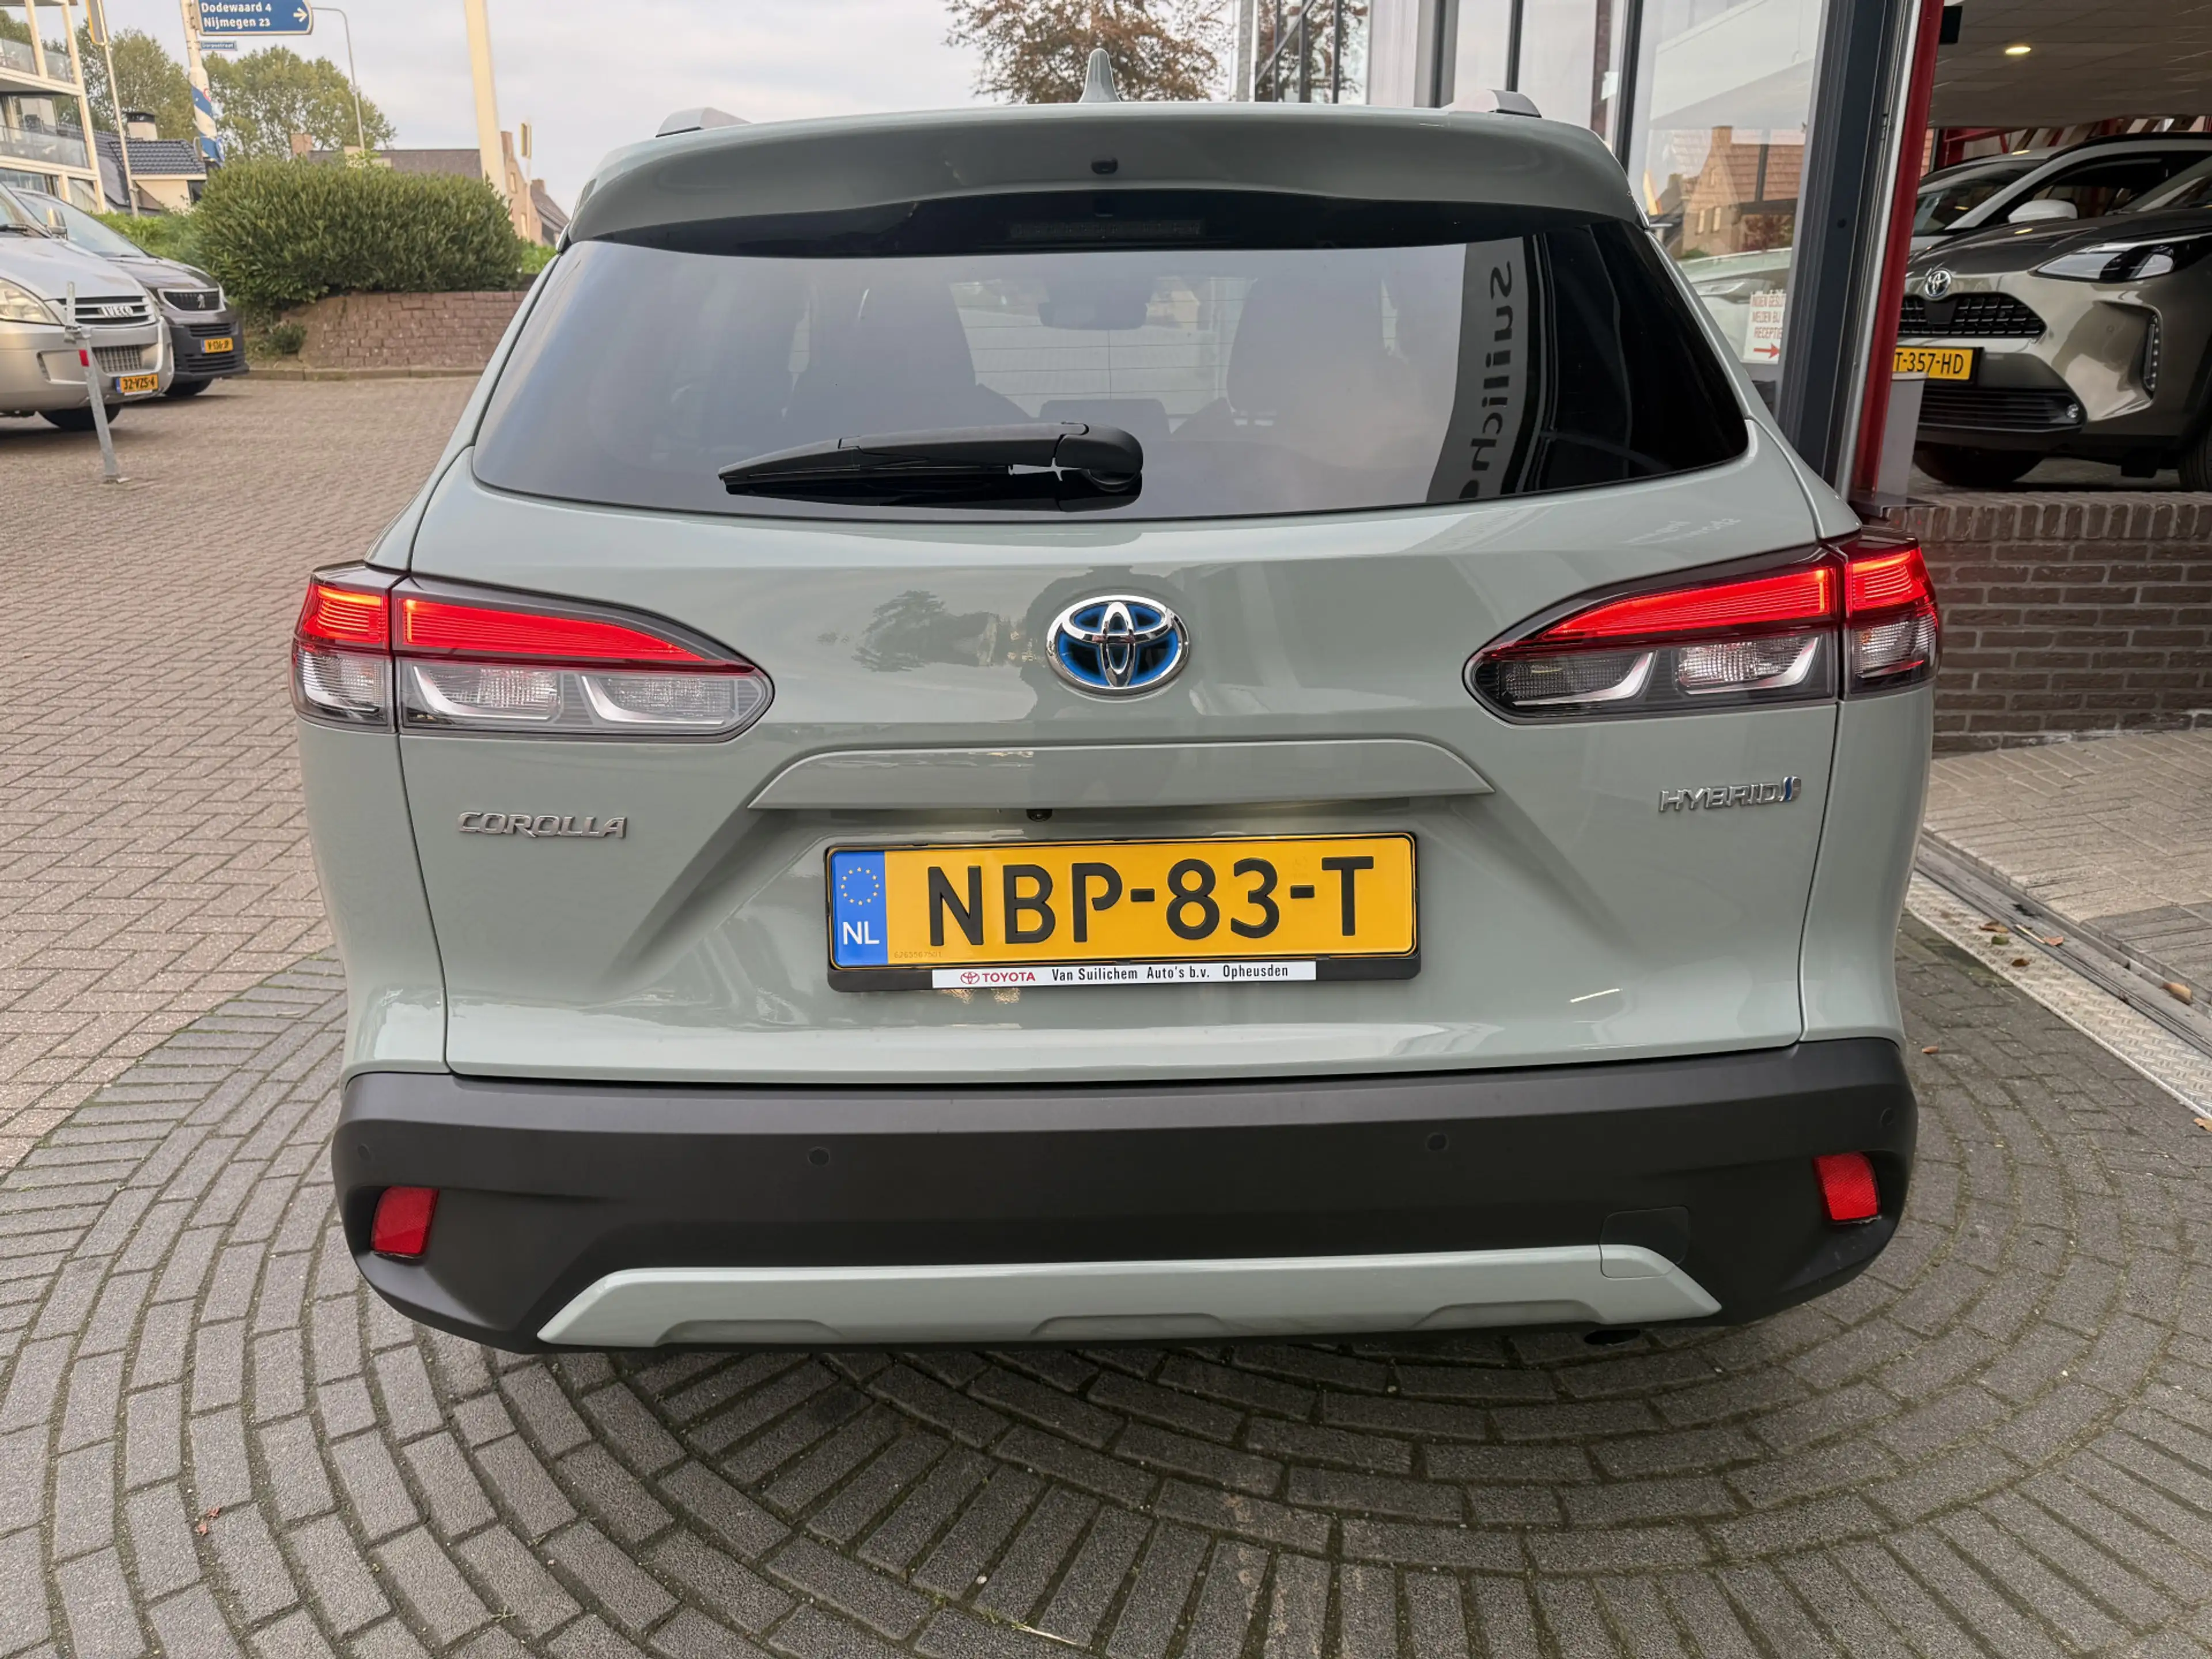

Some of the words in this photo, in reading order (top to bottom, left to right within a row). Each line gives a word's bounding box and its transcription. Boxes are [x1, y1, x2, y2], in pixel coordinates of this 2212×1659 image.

[201, 2, 262, 12] Dodewaard
[265, 3, 272, 12] 4
[203, 17, 256, 29] Nijmegen
[259, 18, 271, 26] 23
[100, 305, 134, 317] IVECO
[1895, 352, 1964, 374] T-357-HD
[1658, 783, 1780, 812] HYBRID
[458, 812, 627, 838] COROLLA
[927, 855, 1374, 946] NBP-83-T
[842, 921, 880, 945] NL
[982, 972, 1036, 983] TOYOTA
[1051, 968, 1073, 981] Van
[1078, 967, 1138, 981] Suilichem
[1146, 965, 1185, 979] Auto's
[1190, 965, 1210, 979] b.v.
[1222, 964, 1289, 980] Opheusden
